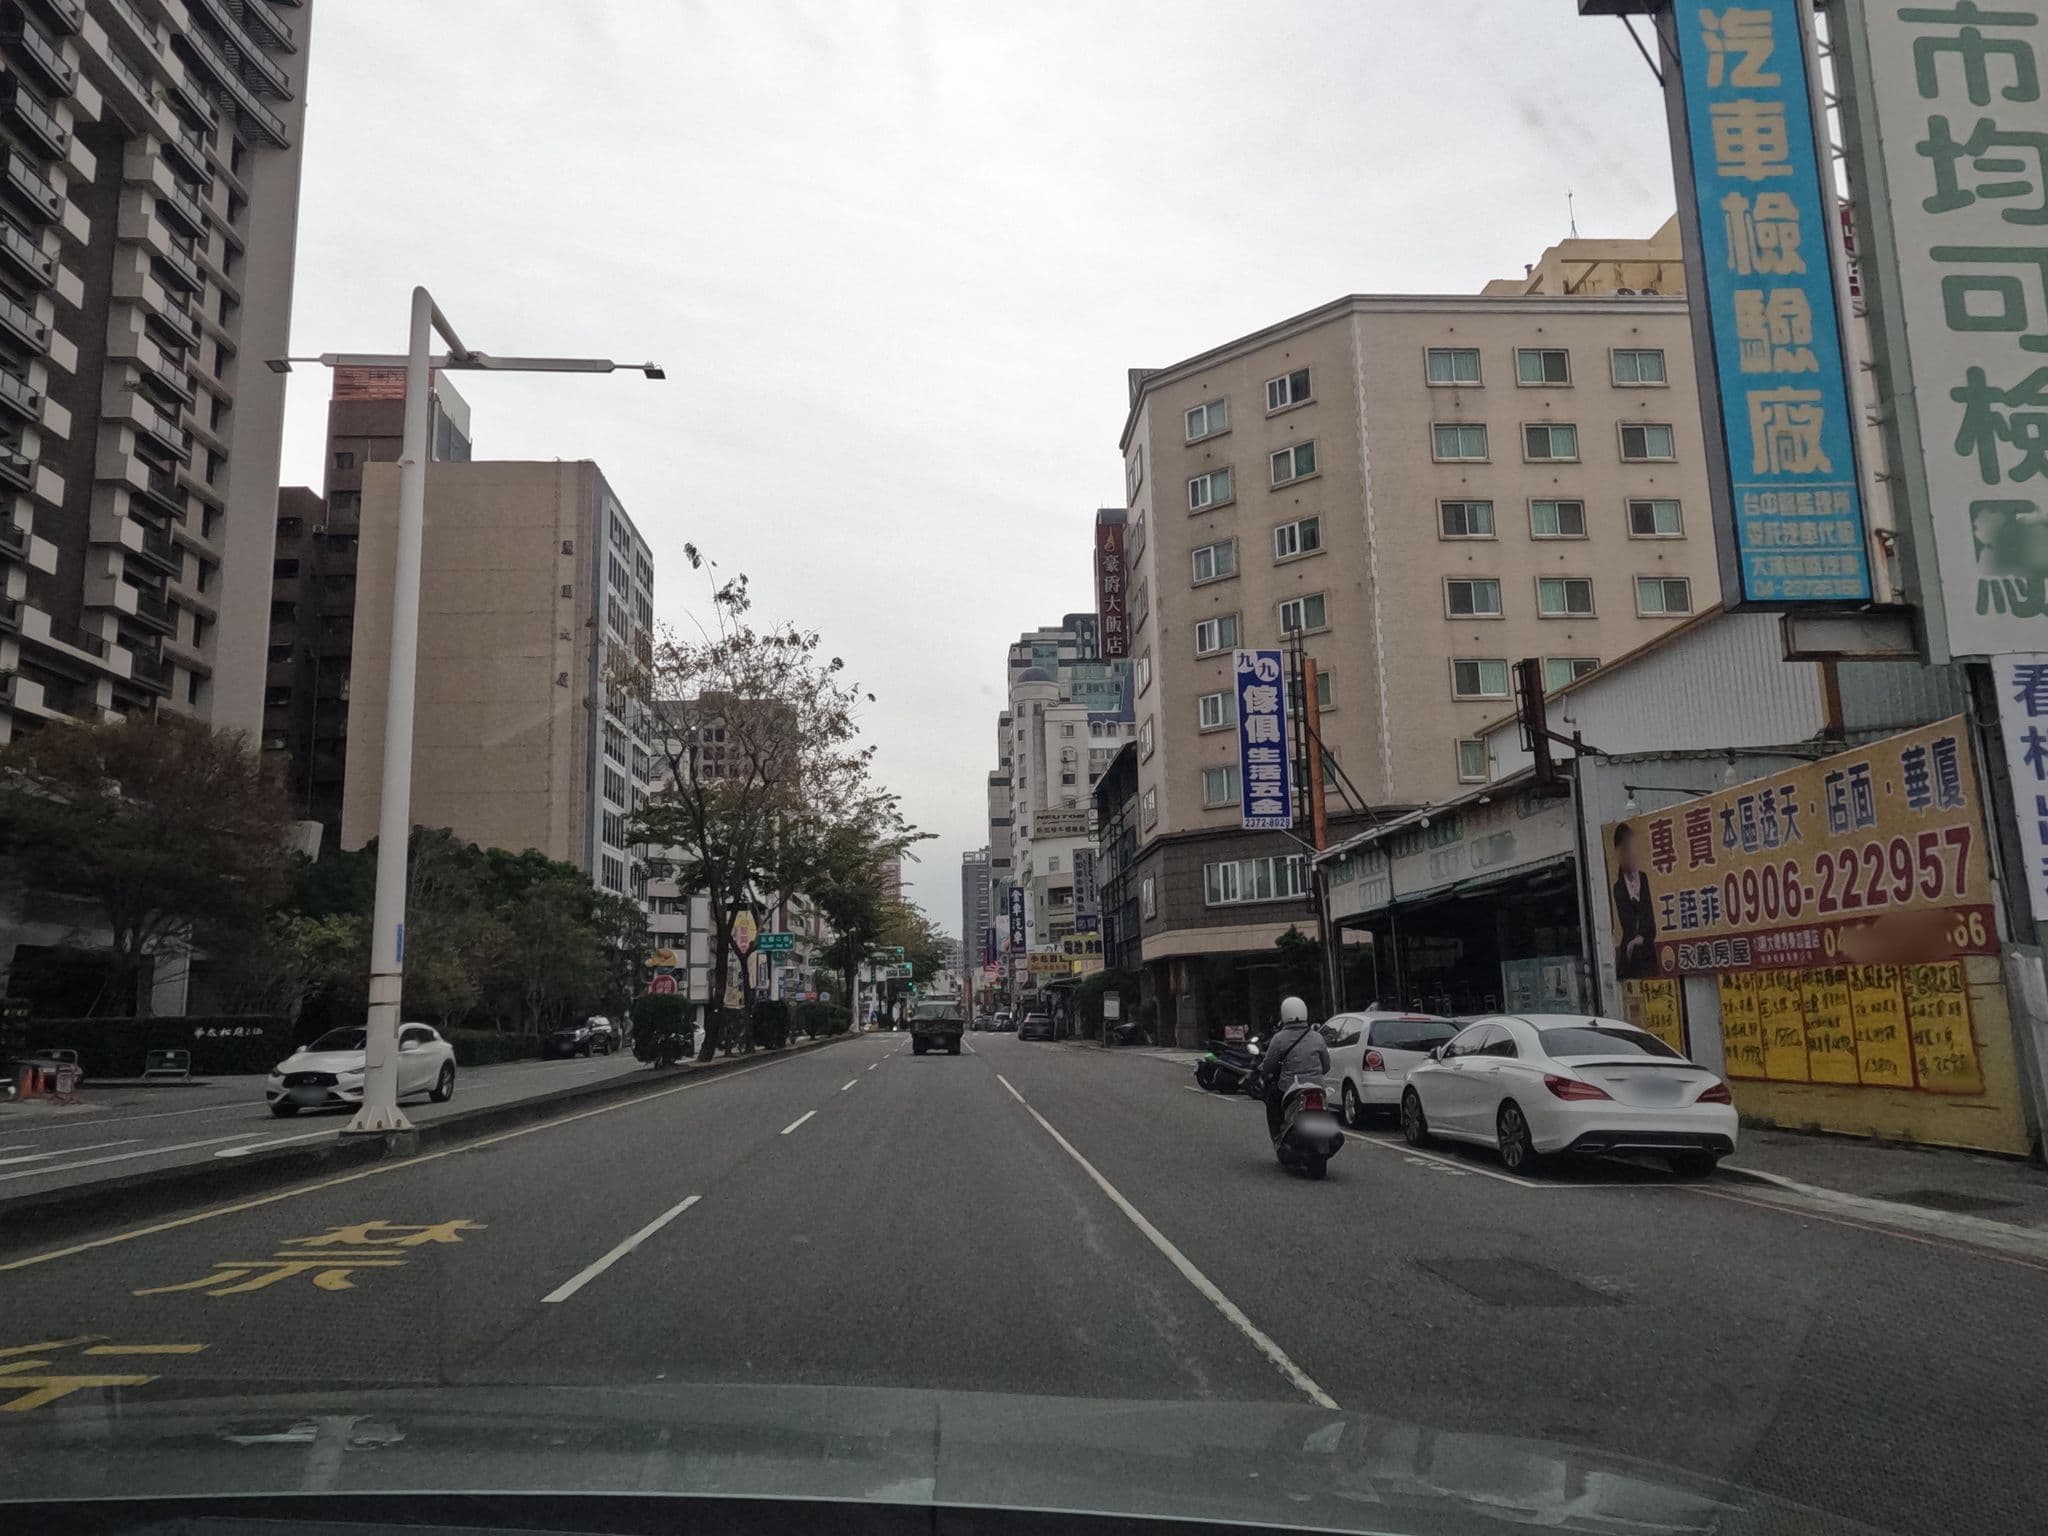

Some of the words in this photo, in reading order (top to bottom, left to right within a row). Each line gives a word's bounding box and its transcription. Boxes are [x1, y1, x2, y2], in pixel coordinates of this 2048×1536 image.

[1700, 8, 1831, 476] 汽車檢驗廠
[1659, 883, 1720, 934] 王語菲
[1723, 825, 1972, 927] 0906-222957
[1678, 937, 1752, 970] 永義房屋
